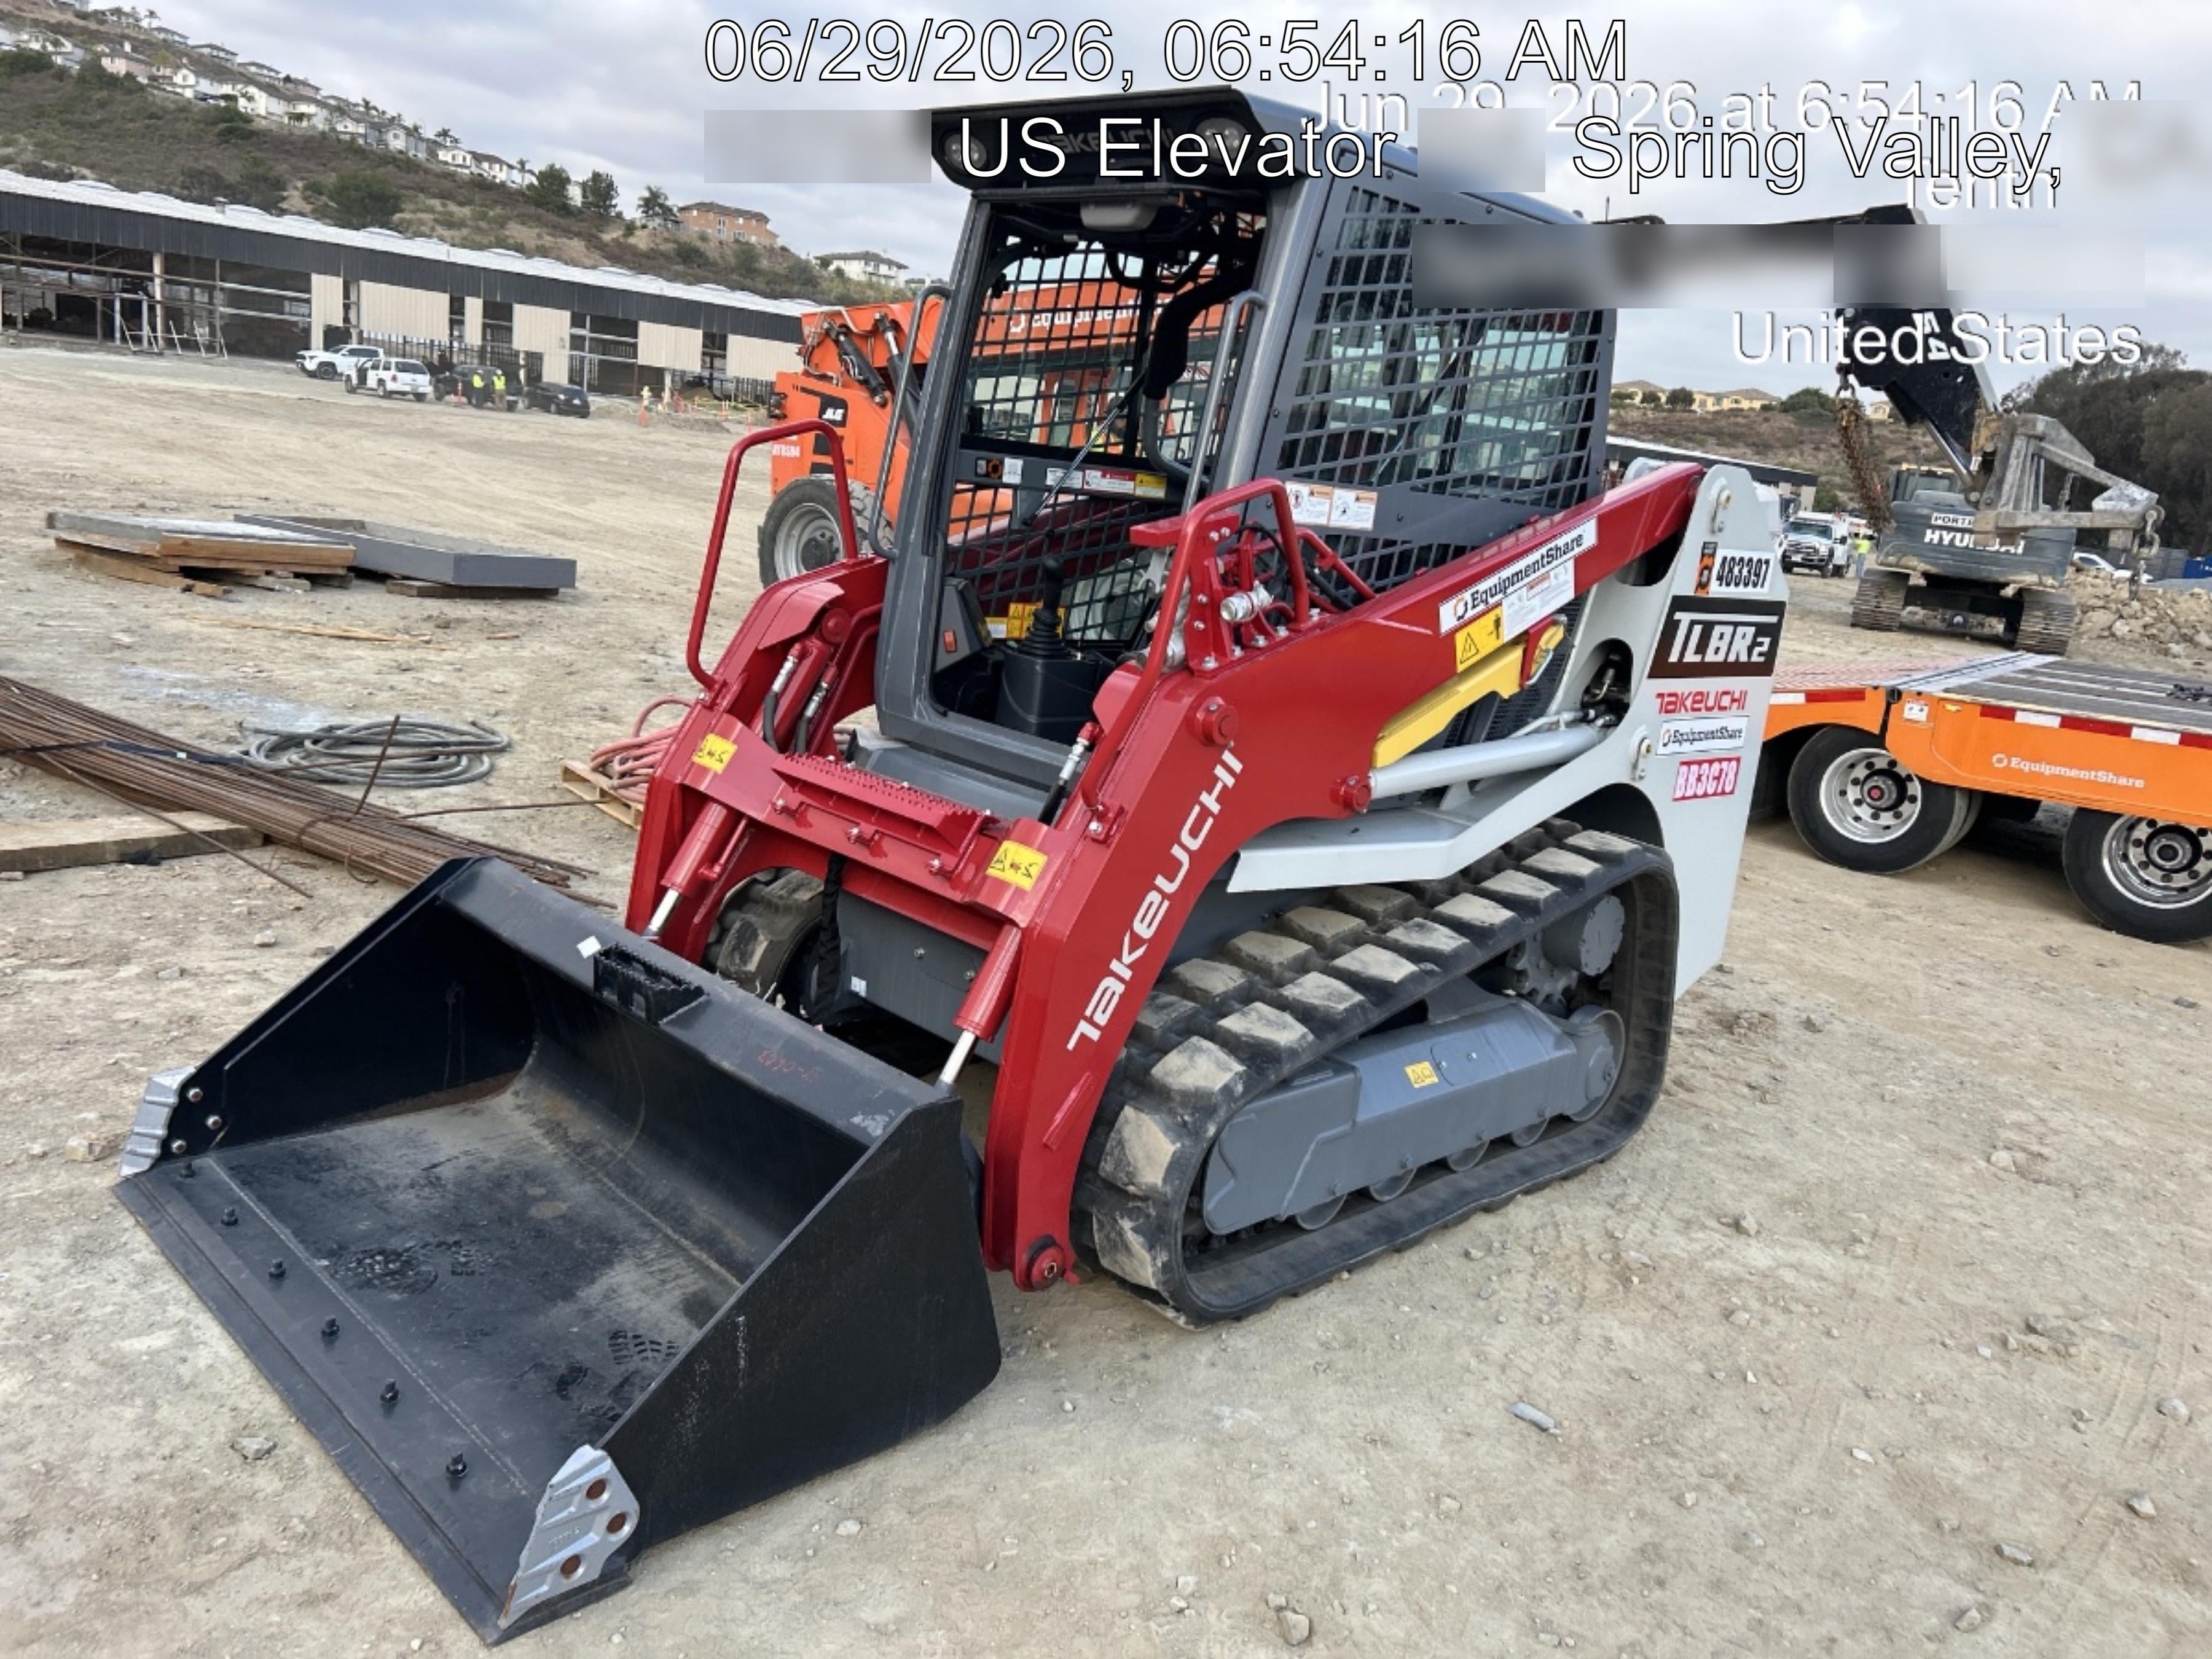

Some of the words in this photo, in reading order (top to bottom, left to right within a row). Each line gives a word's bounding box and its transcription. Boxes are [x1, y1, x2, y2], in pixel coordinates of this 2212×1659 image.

[1471, 533, 1585, 610] EquipmentShare
[1716, 555, 1771, 589] 483397
[1655, 689, 1747, 714] TAKEUCHI
[1672, 726, 1743, 747] EquipmentShare
[2010, 756, 2145, 788] EquipmentShare
[1067, 749, 1244, 1051] TAKEUCHI
